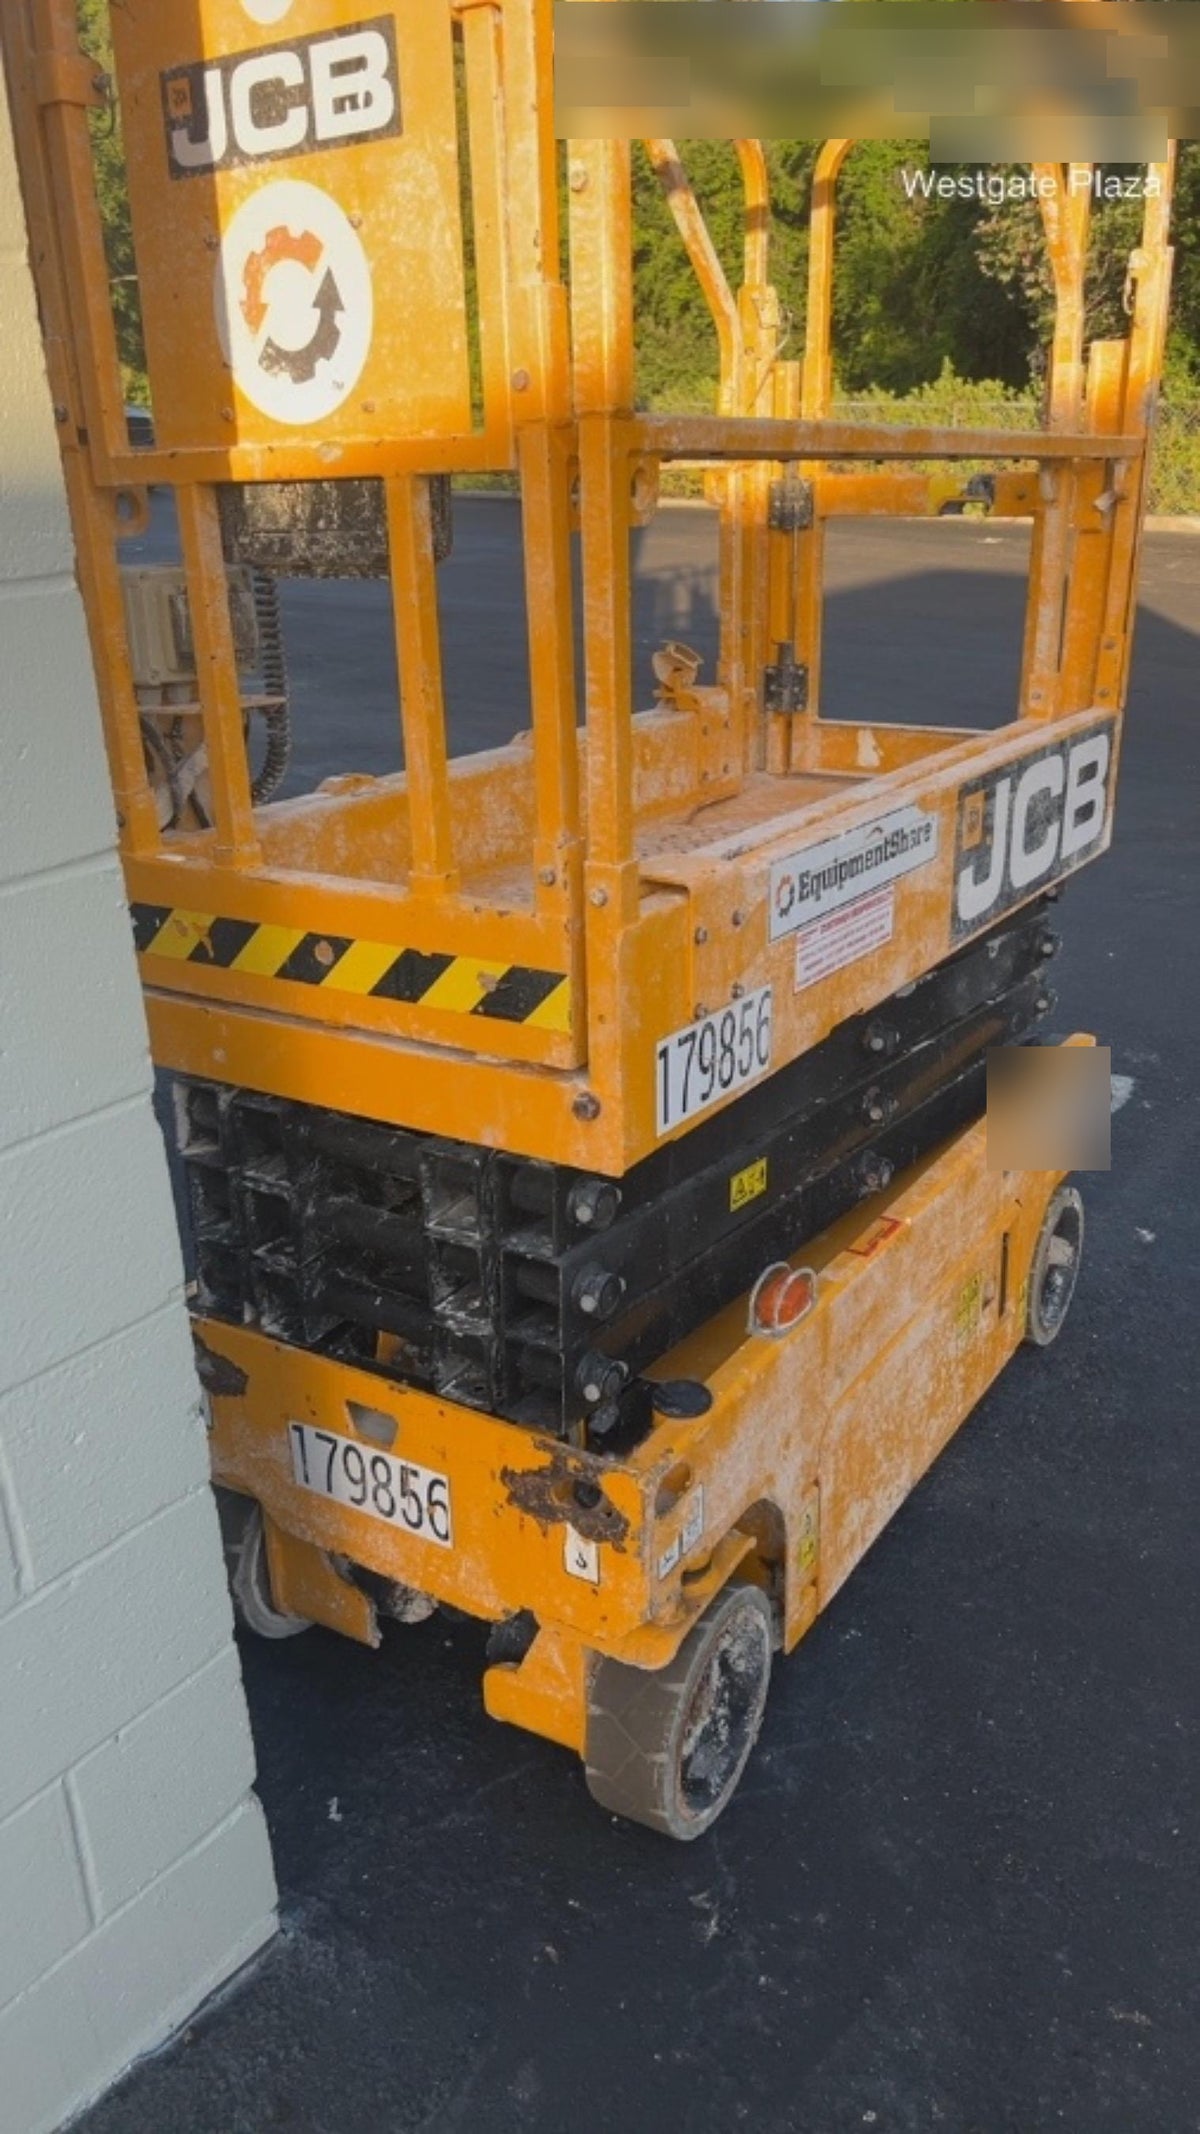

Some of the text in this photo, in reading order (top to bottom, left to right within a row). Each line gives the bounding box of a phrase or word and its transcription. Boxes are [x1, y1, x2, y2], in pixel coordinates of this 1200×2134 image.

[172, 30, 395, 167] JCB
[797, 821, 933, 904] EquipmentShare
[957, 734, 1109, 921] JCB
[659, 990, 771, 1124] 179856
[292, 1424, 449, 1541] 179856
